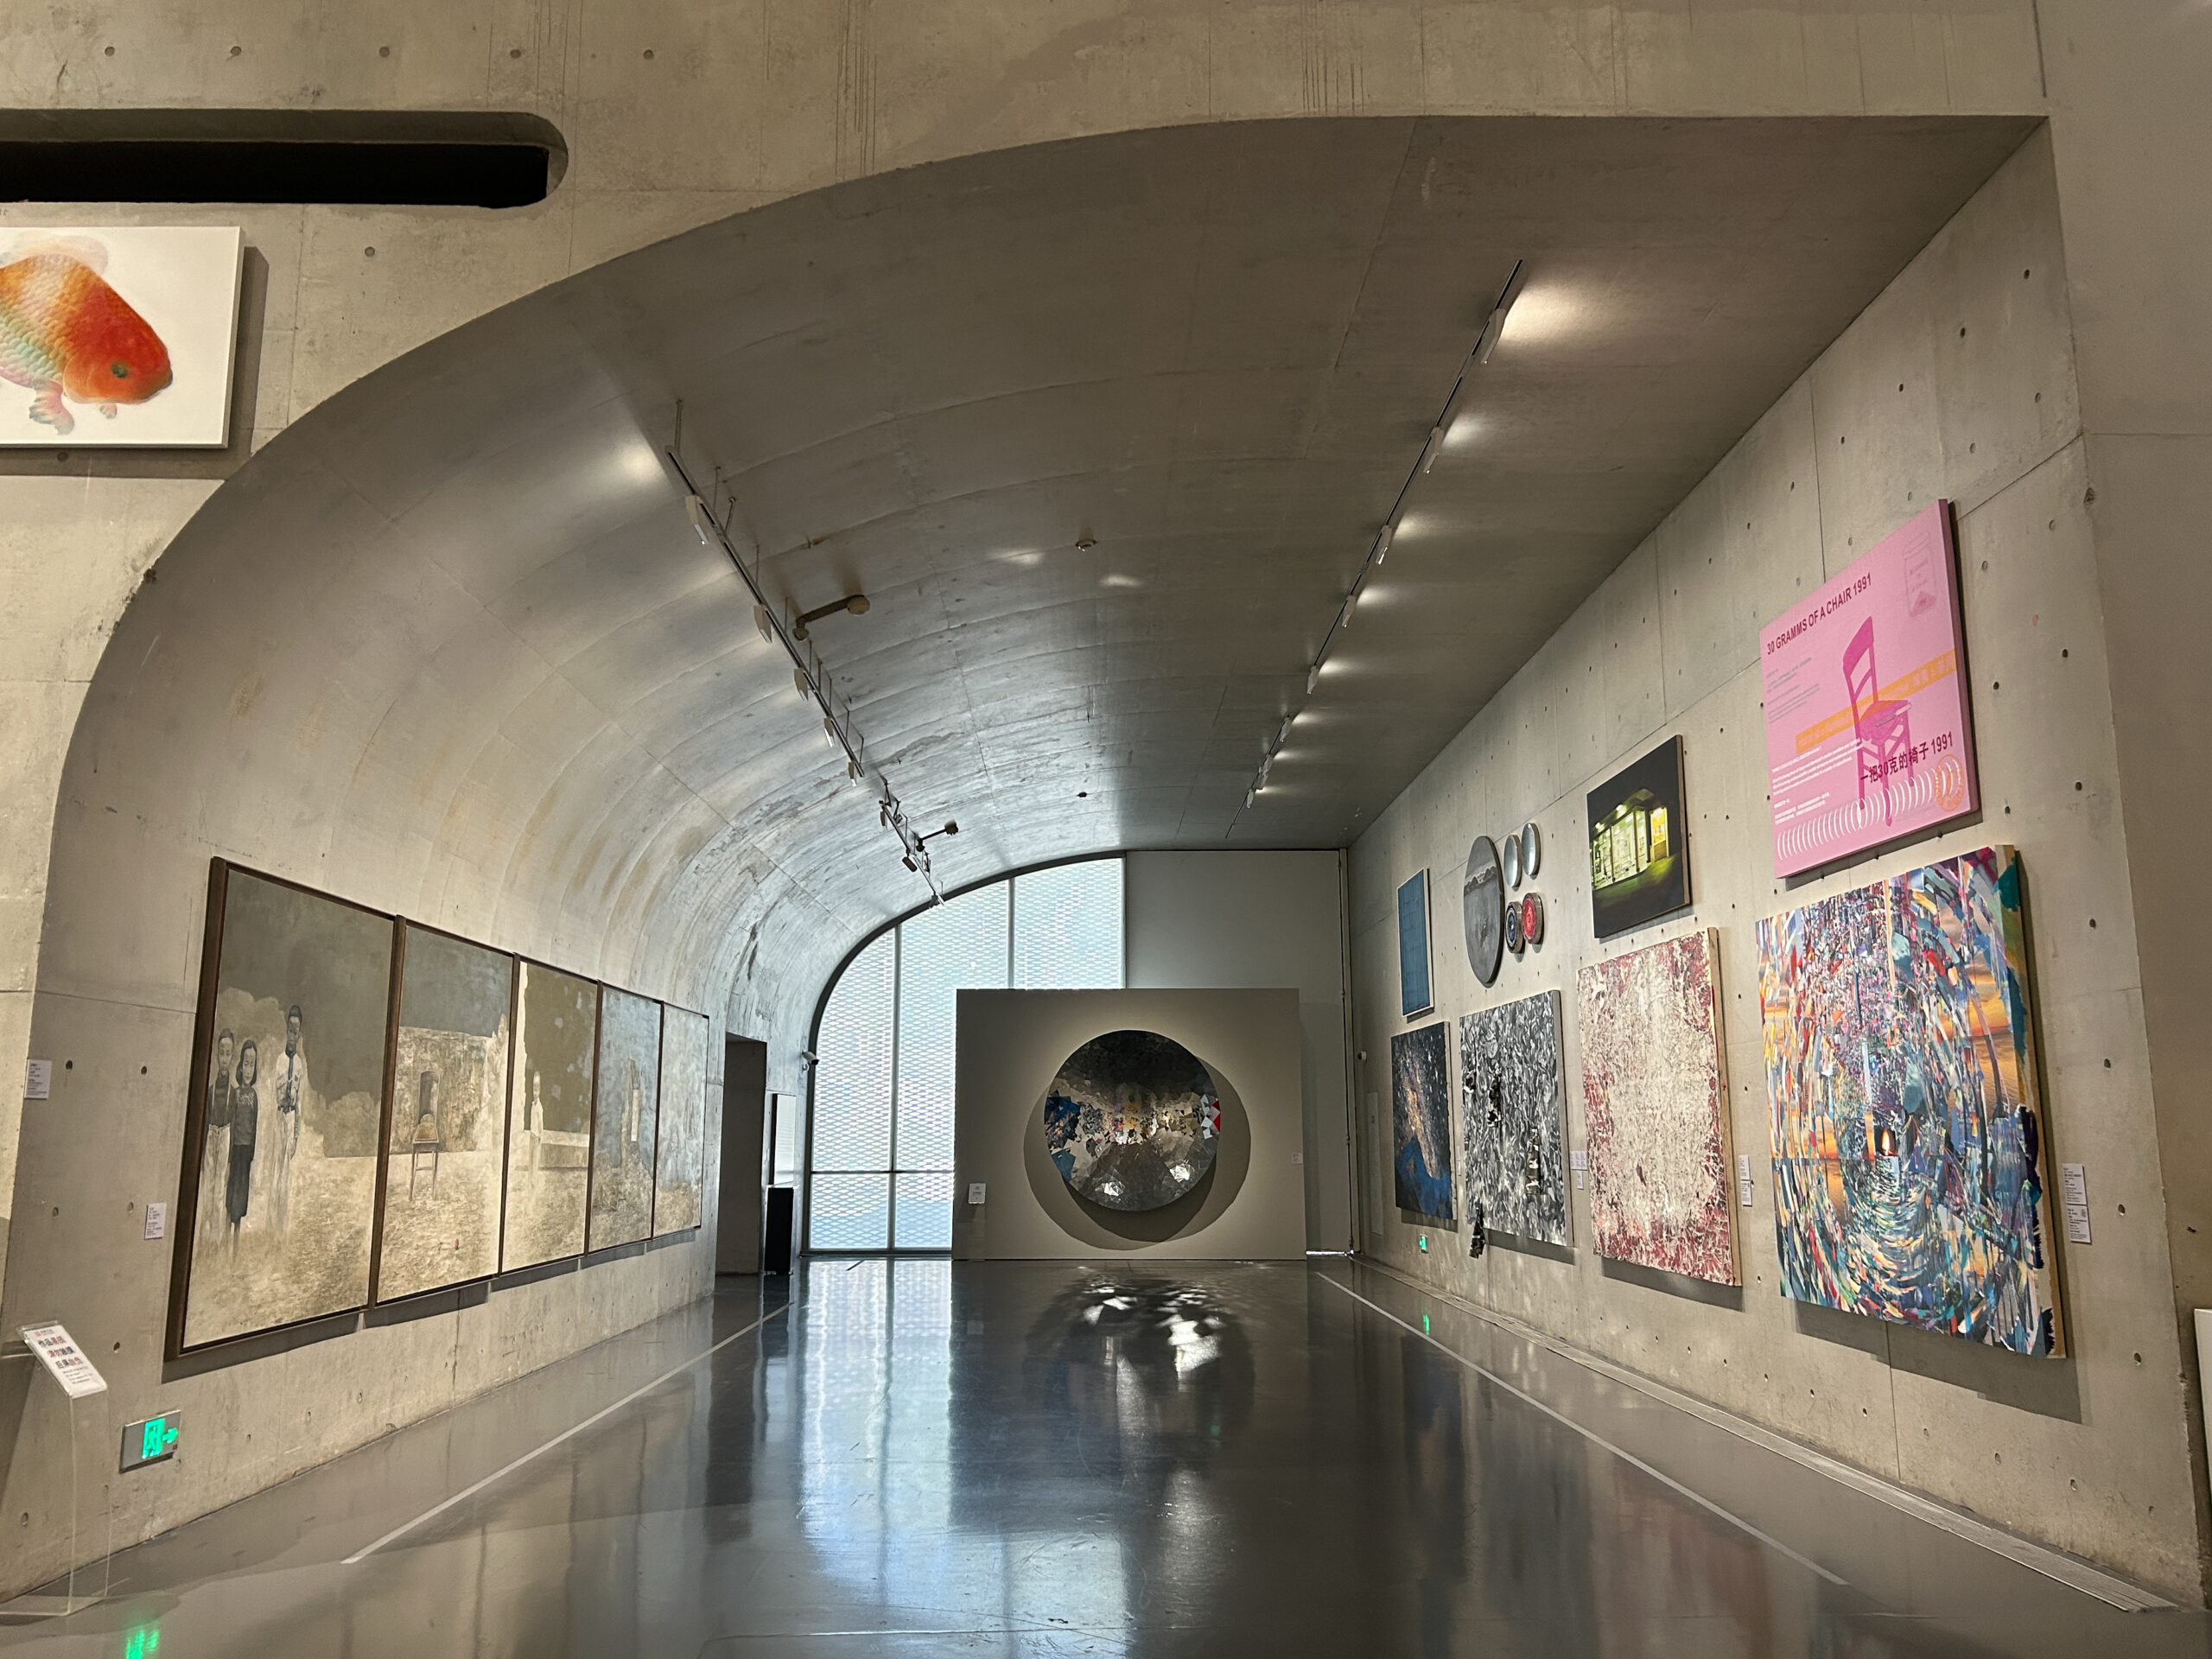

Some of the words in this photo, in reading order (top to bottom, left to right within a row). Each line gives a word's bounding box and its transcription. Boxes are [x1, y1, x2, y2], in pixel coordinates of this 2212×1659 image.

[1767, 640, 1776, 655] 30
[1776, 619, 1808, 649] GRAMMS
[1808, 610, 1819, 627] OF
[1820, 607, 1827, 620] A
[1826, 588, 1852, 614] CHAIR
[1853, 572, 1872, 596] 1991
[1859, 741, 1929, 783] 一把30克的椅子
[1930, 731, 1954, 754] 1991
